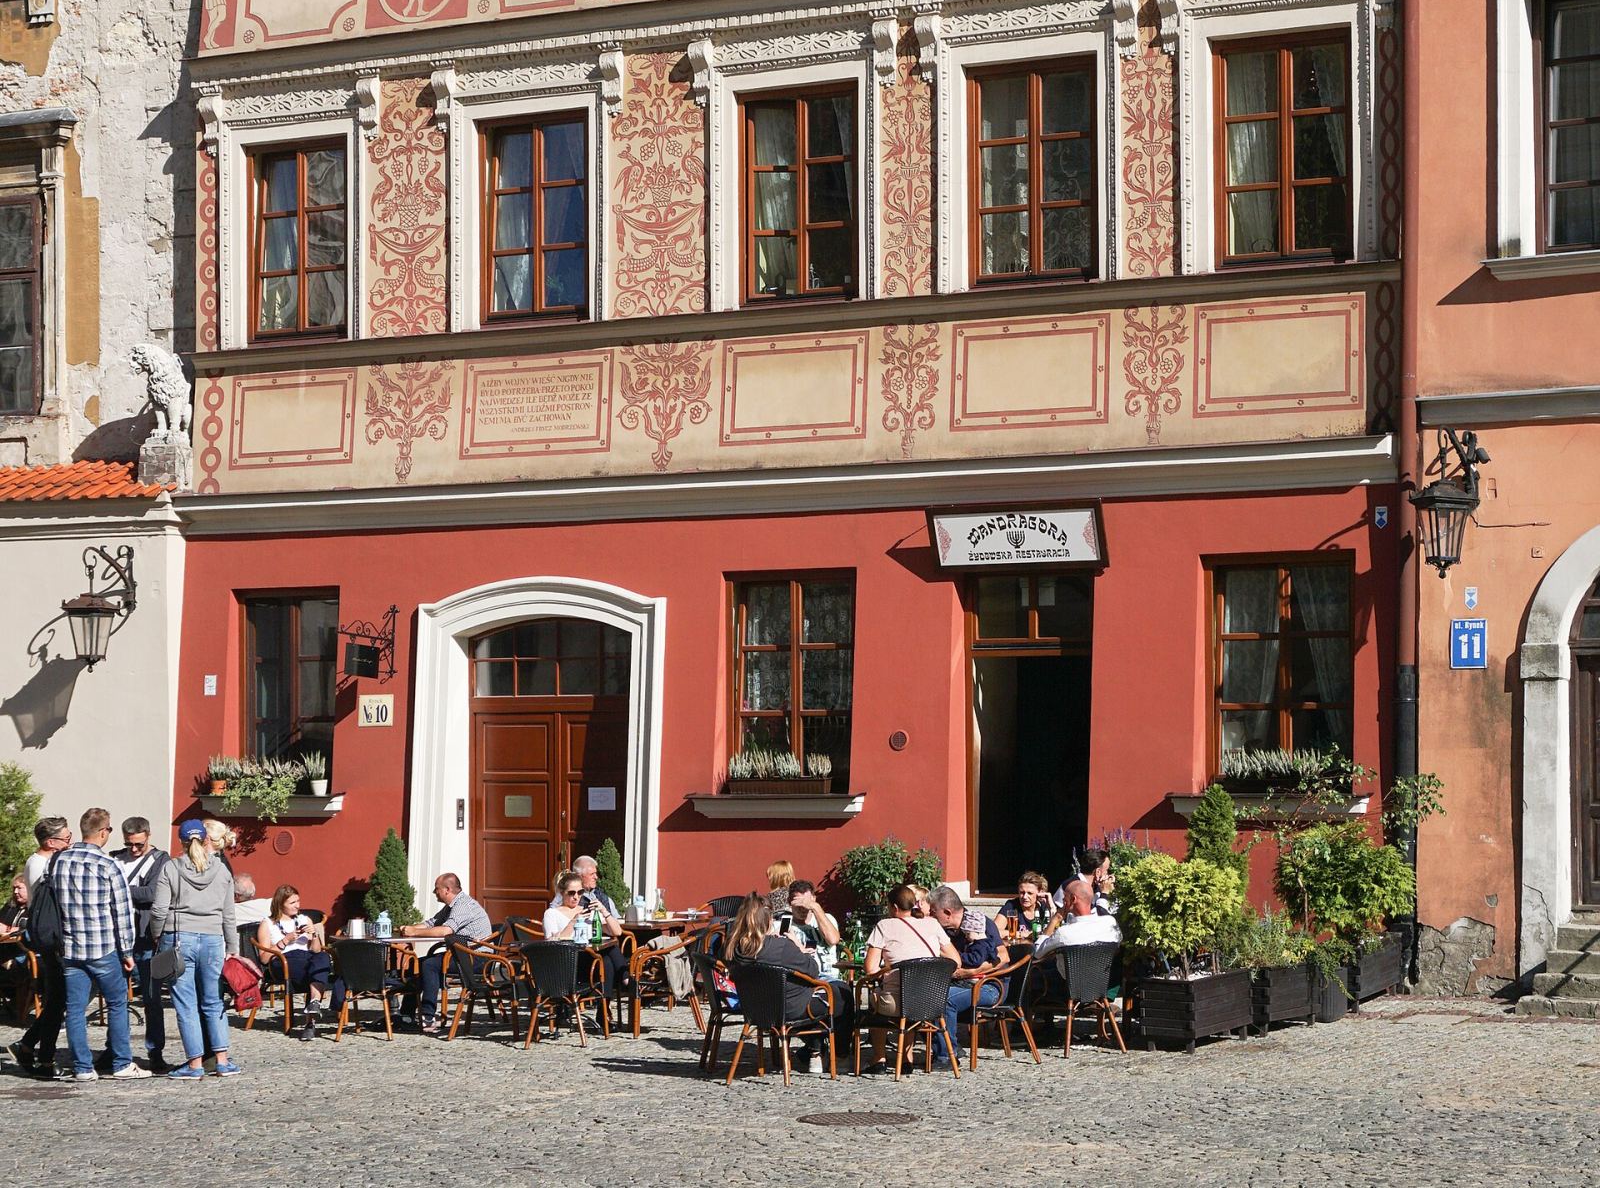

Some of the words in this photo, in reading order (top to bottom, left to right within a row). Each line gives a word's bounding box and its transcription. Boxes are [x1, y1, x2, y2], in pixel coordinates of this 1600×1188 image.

[504, 377, 530, 387] WOJNY
[557, 374, 580, 383] NIGDY
[580, 372, 593, 382] NIE
[525, 395, 538, 404] ILE
[966, 513, 1068, 548] MANDRAGORA
[968, 550, 1013, 561] ŻYDOWSKA
[1015, 548, 1071, 559] RESTAURACJA
[1464, 621, 1484, 630] Rynek
[1459, 633, 1480, 659] 11
[375, 704, 388, 723] 10
